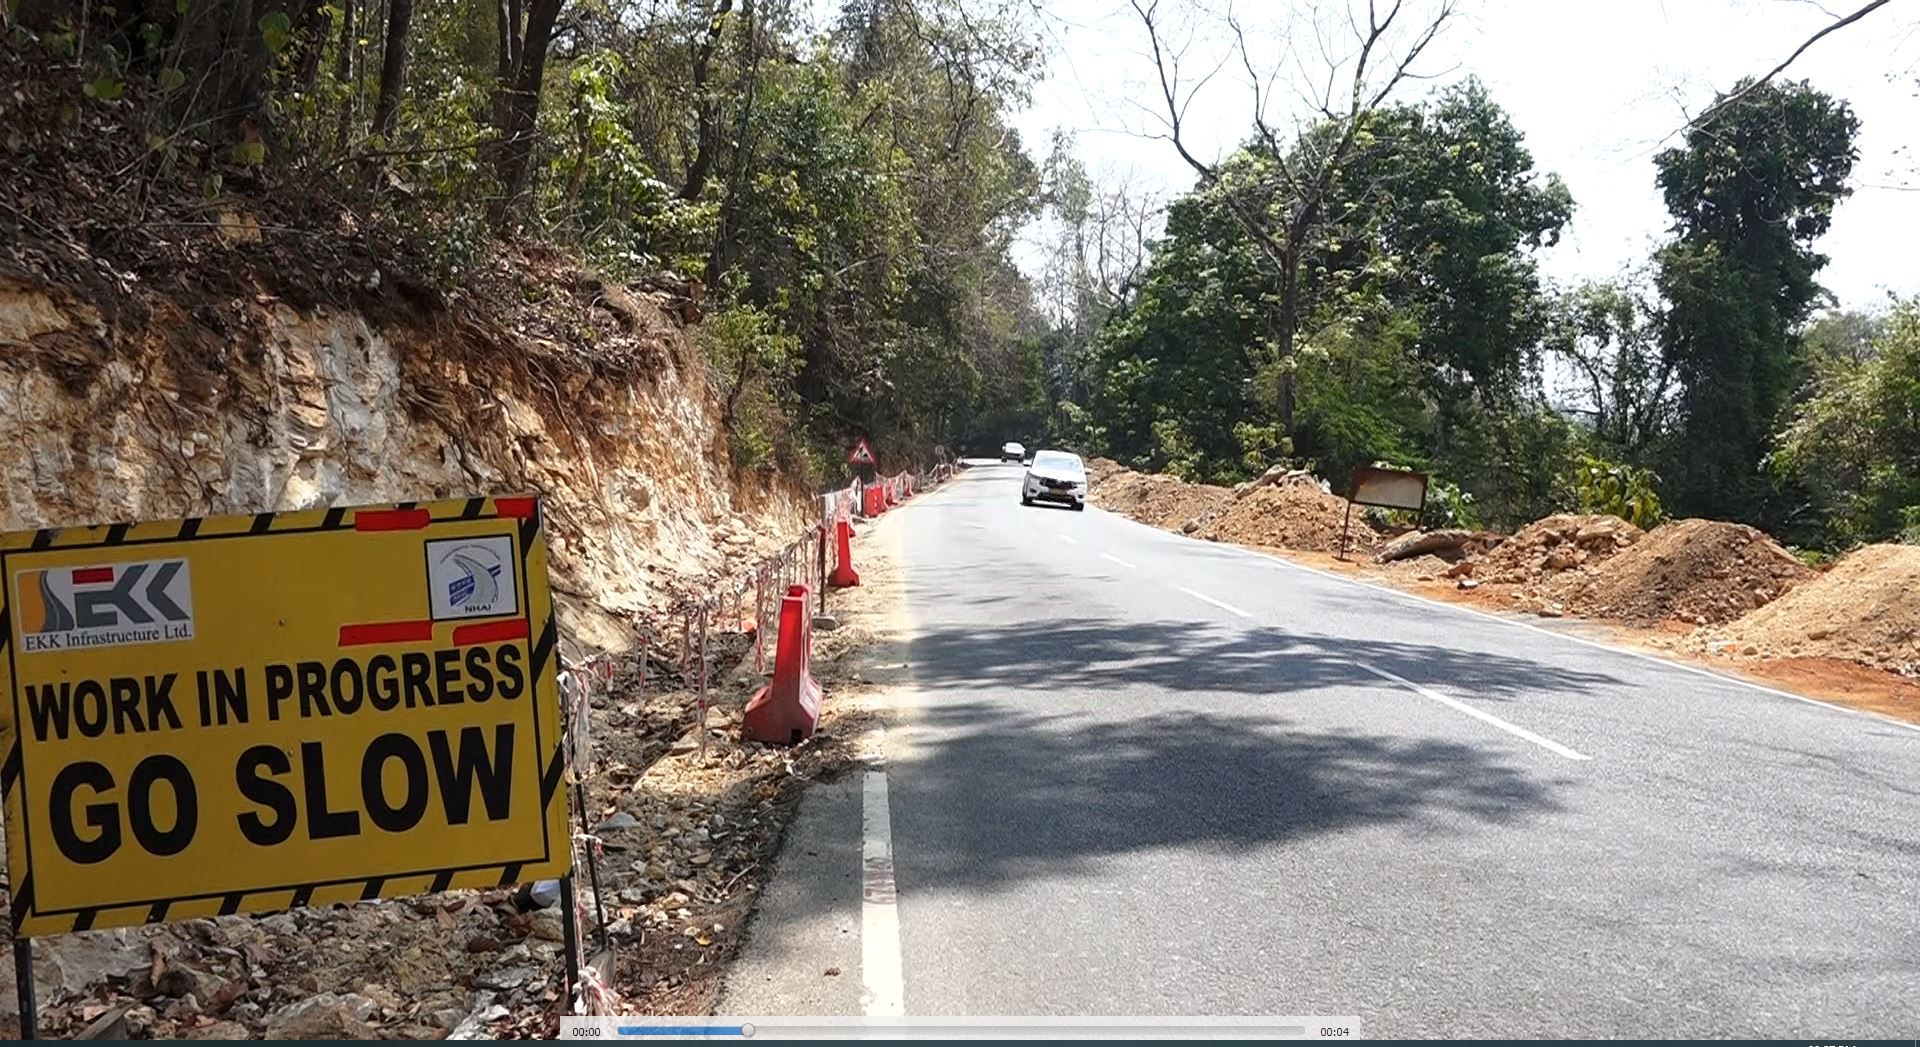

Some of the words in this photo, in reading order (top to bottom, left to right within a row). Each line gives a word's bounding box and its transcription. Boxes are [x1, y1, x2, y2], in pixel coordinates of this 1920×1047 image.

[25, 635, 61, 651] EKK
[66, 630, 159, 647] Infrastructure
[164, 623, 192, 639] Ltd.
[464, 604, 492, 613] NHAI
[25, 673, 183, 742] WORK
[196, 667, 249, 727] IN
[266, 644, 524, 721] PROGRESS
[49, 754, 199, 865] GO
[235, 723, 515, 846] SLOW
